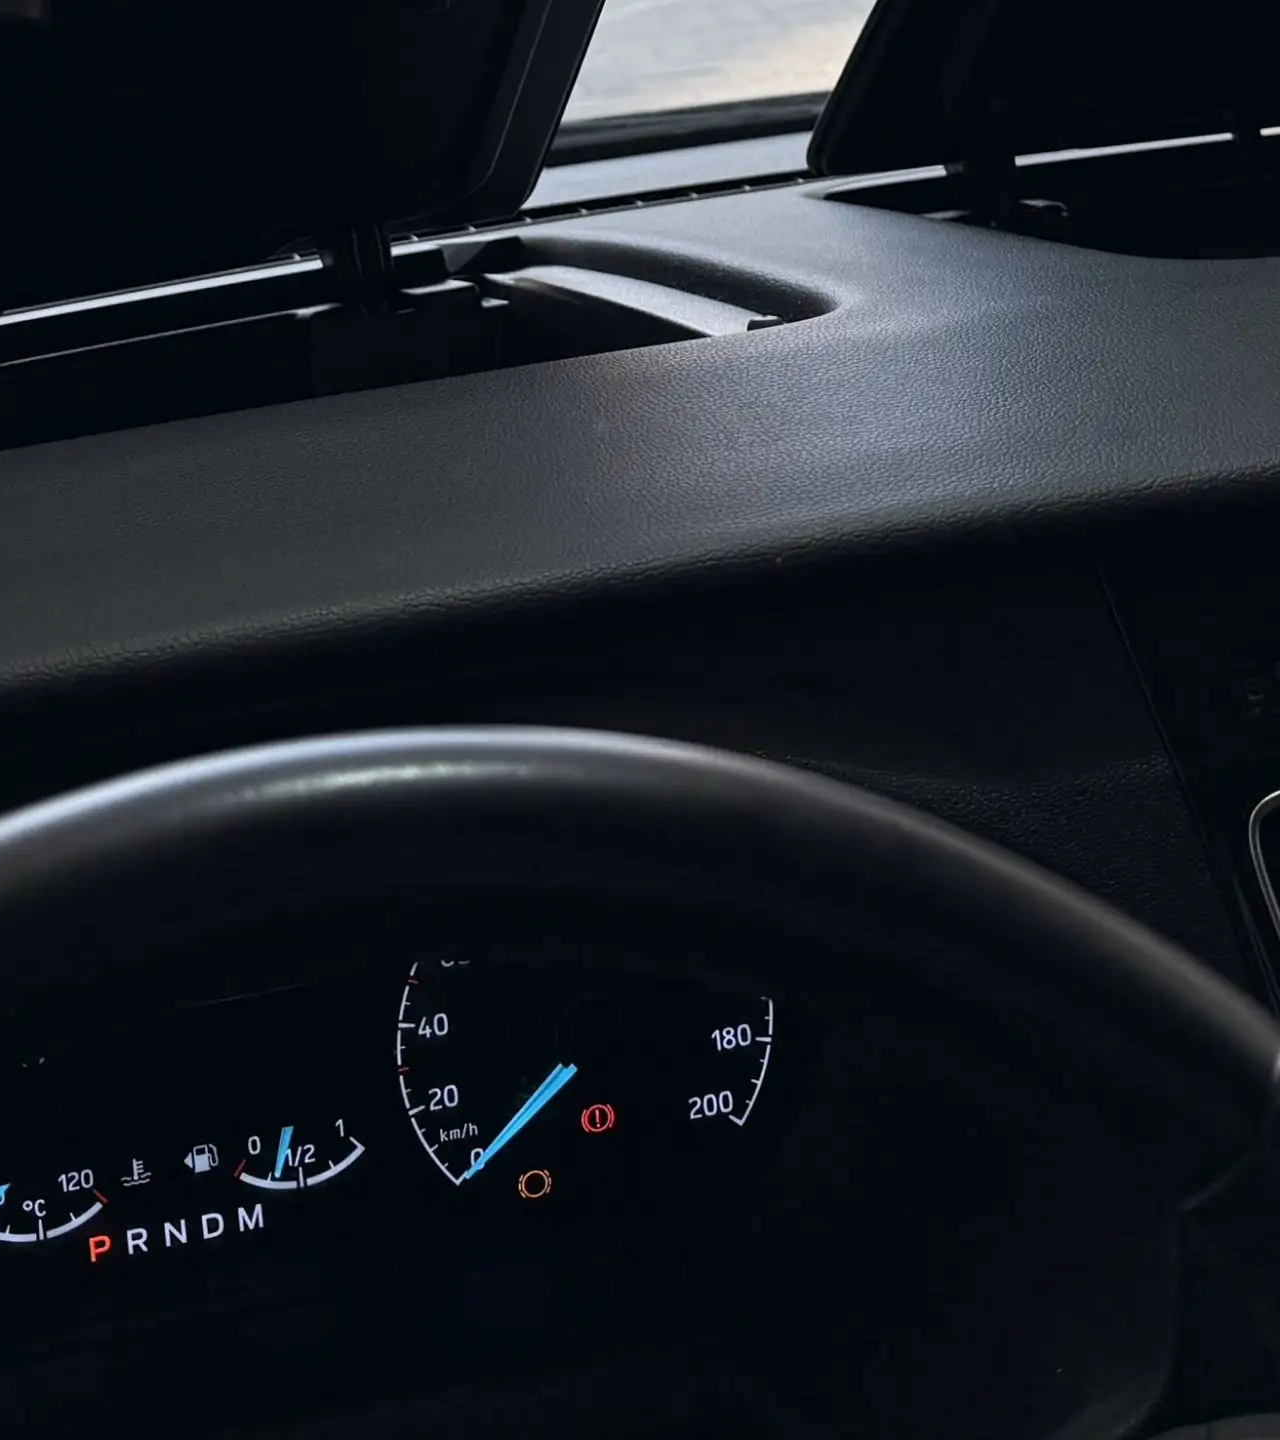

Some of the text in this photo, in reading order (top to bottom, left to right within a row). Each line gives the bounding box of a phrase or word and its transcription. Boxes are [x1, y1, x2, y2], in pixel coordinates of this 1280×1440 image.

[418, 1012, 449, 1038] 40
[711, 1023, 752, 1051] 180
[428, 1084, 459, 1111] 20
[688, 1090, 733, 1119] 200
[247, 1118, 345, 1167] 0 1/2 1
[439, 1123, 478, 1142] km/h
[57, 1169, 94, 1193] 120
[88, 1203, 264, 1262] P R N D M
